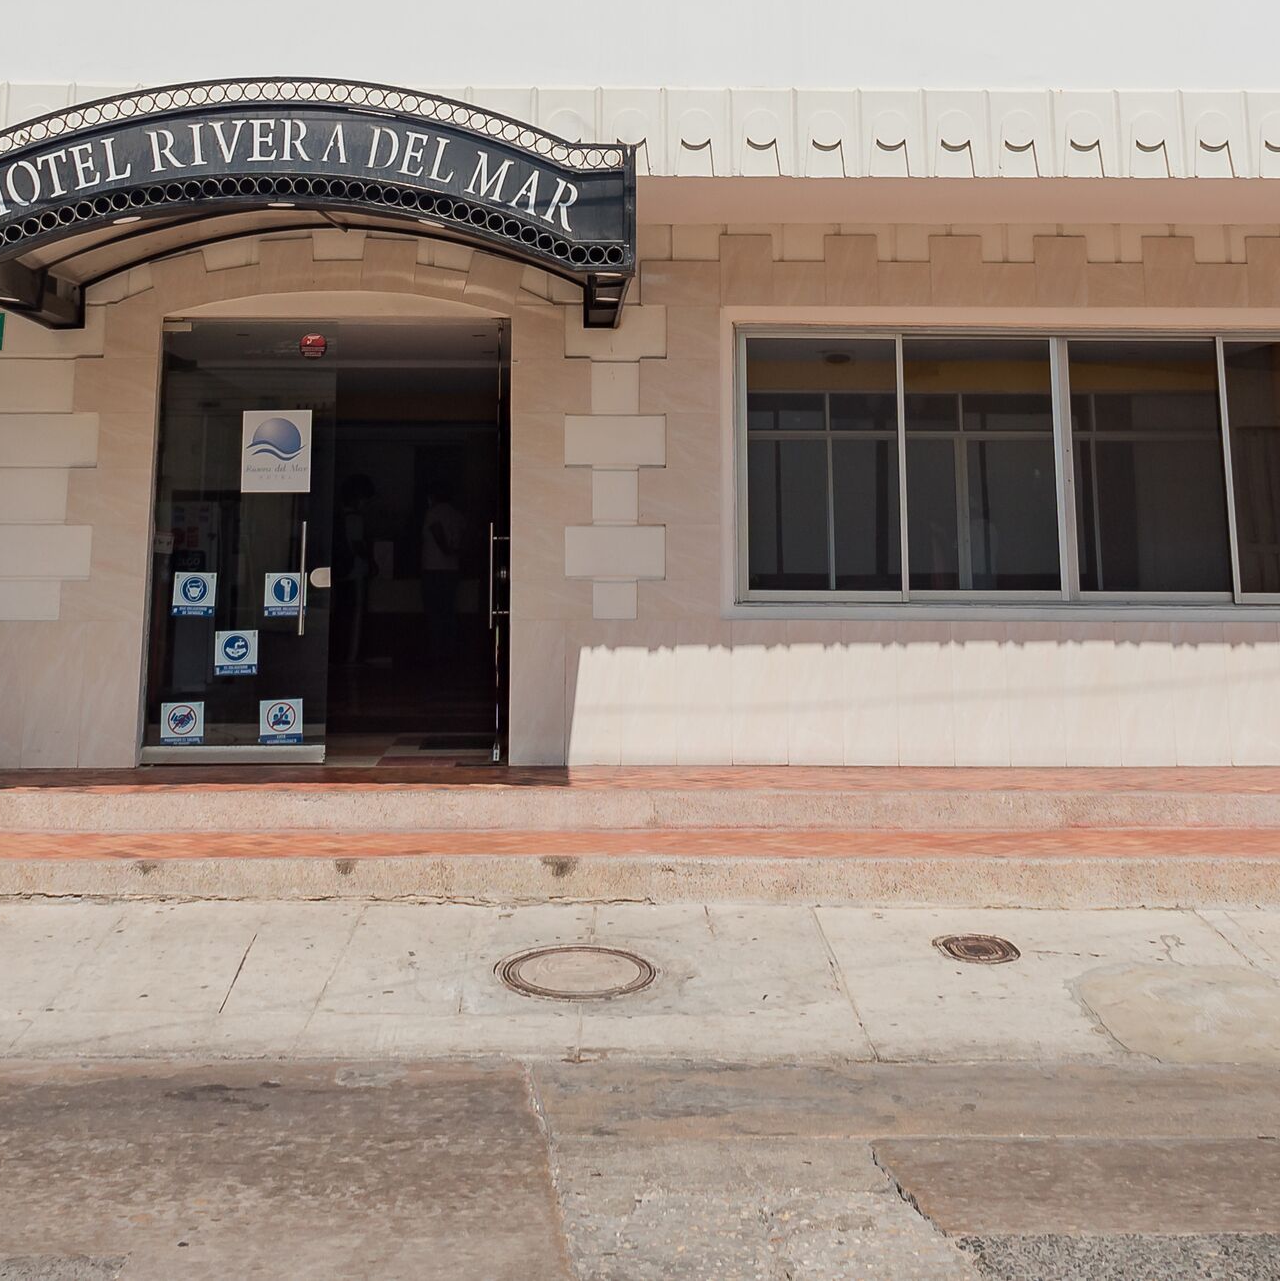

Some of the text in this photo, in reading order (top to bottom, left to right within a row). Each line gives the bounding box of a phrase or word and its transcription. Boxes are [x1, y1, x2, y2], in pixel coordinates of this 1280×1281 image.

[144, 118, 348, 173] RIVERA
[368, 125, 455, 186] DEL
[463, 150, 580, 233] MAR
